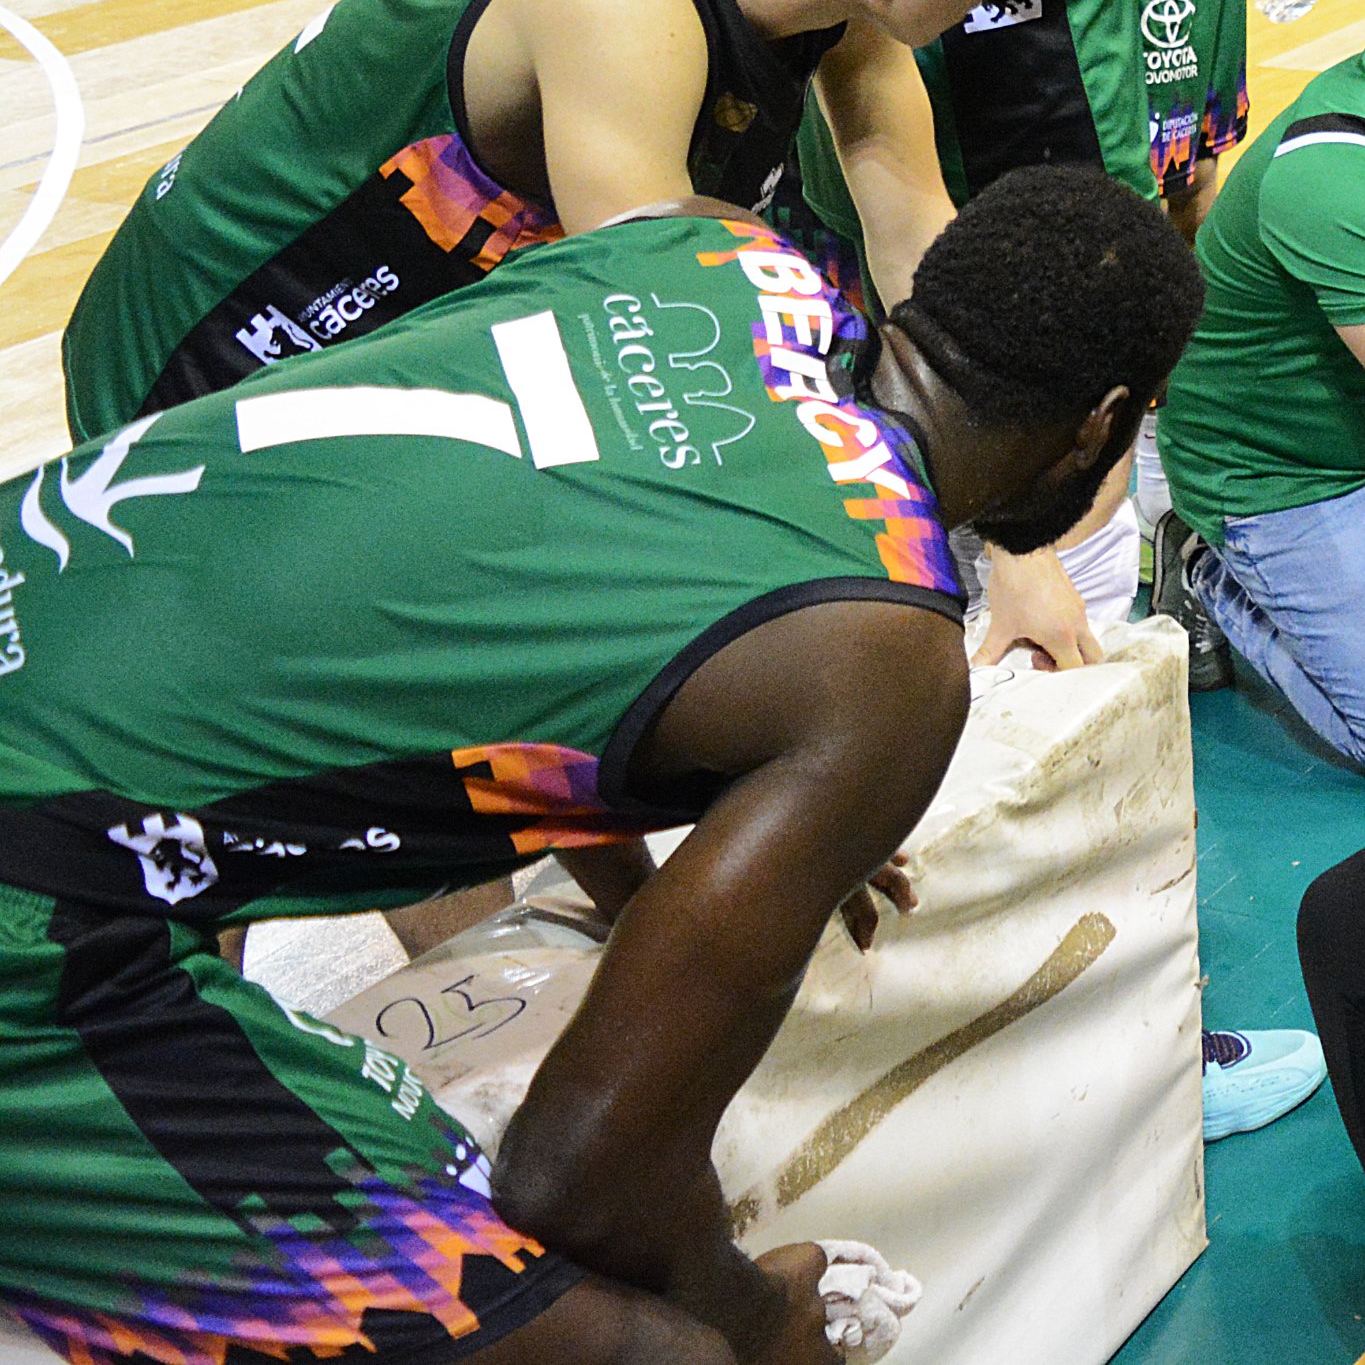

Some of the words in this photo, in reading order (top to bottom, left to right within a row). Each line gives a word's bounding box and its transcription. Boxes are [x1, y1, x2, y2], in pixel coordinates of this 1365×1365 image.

[1145, 65, 1198, 85] OVOMOTOR
[603, 293, 701, 471] cáceres
[737, 249, 911, 501] BERCY
[375, 974, 528, 1052] 25
